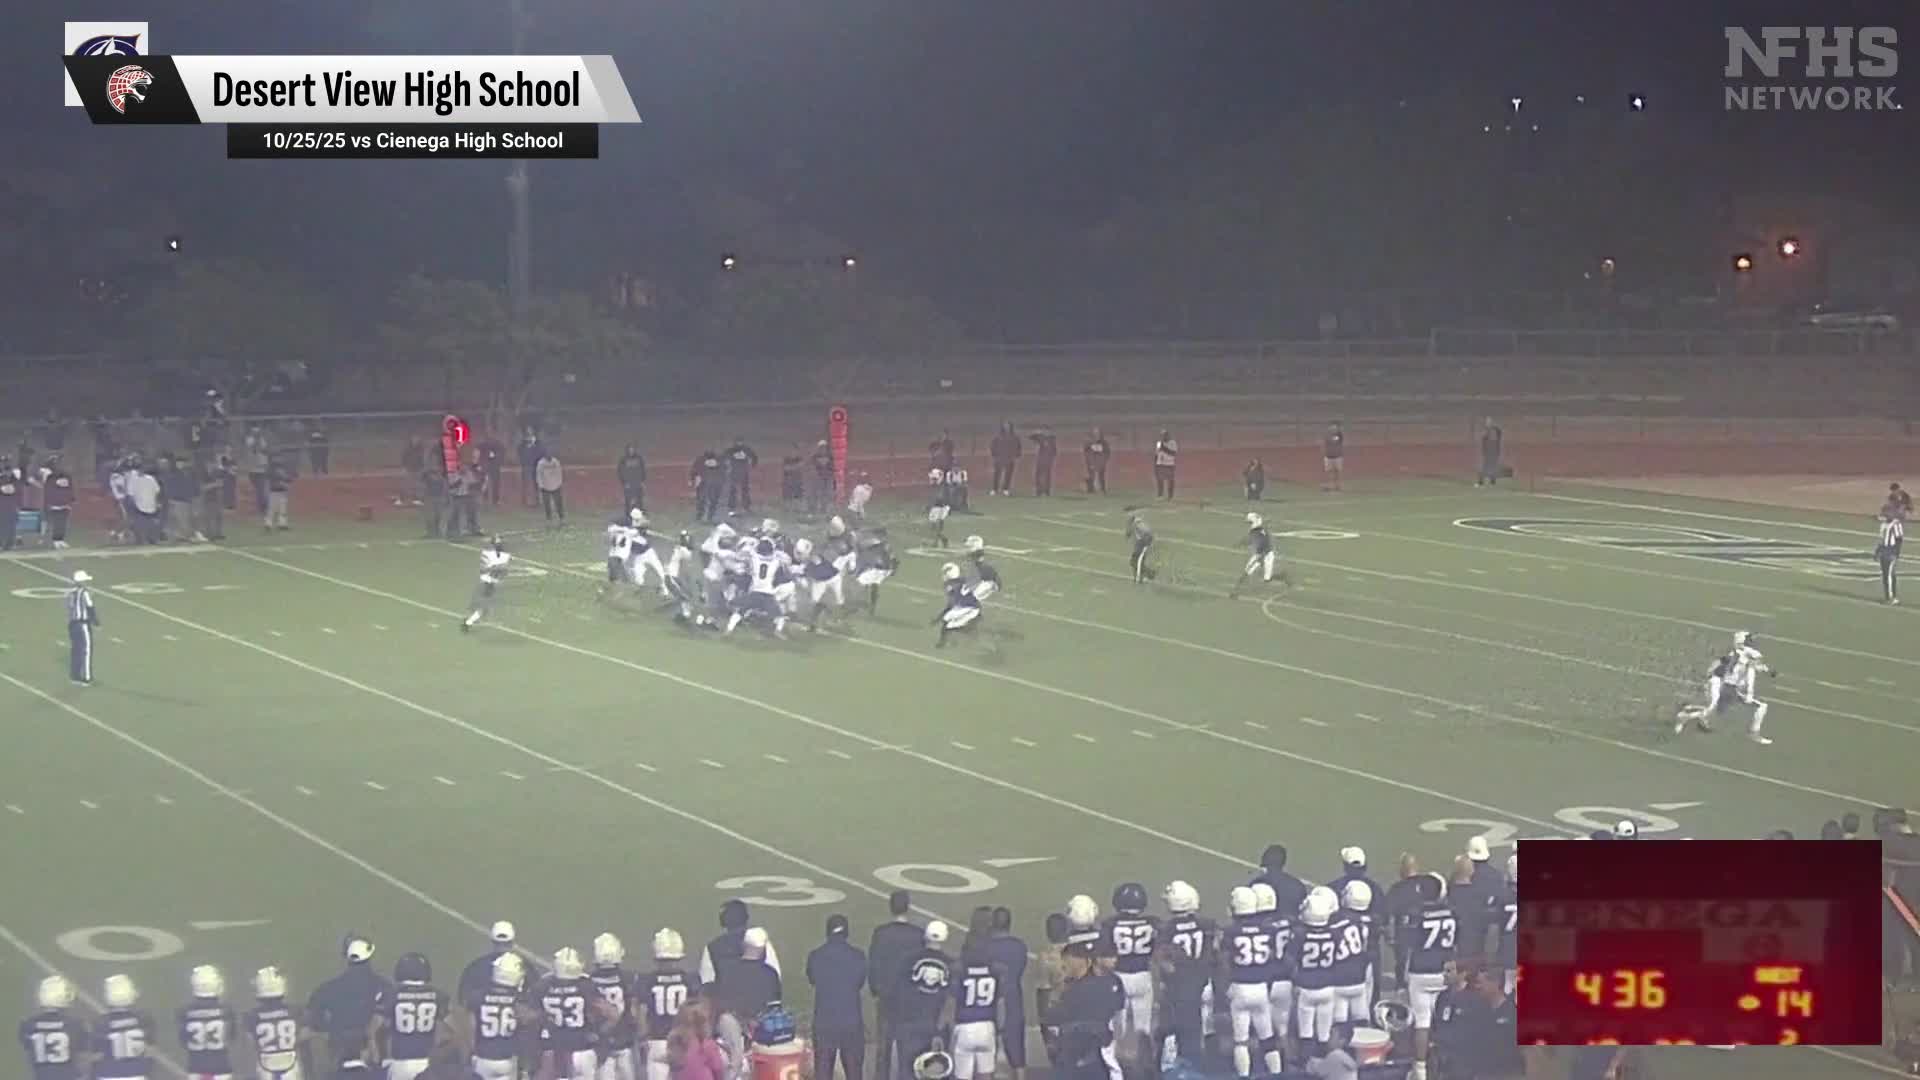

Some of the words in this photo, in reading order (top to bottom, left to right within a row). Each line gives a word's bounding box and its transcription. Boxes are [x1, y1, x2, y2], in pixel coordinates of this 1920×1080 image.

[1113, 924, 1154, 955] 62
[1422, 917, 1457, 949] 73
[1233, 934, 1270, 965] 35
[1302, 941, 1335, 968] 23
[651, 984, 688, 1016] 10
[963, 976, 997, 1006] 19
[1777, 990, 1813, 1018] 14
[394, 1002, 438, 1034] 68
[480, 1004, 517, 1038] 56
[543, 996, 585, 1028] 53
[30, 1031, 70, 1063] 13
[186, 1019, 225, 1050] 33
[256, 1019, 297, 1052] 28
